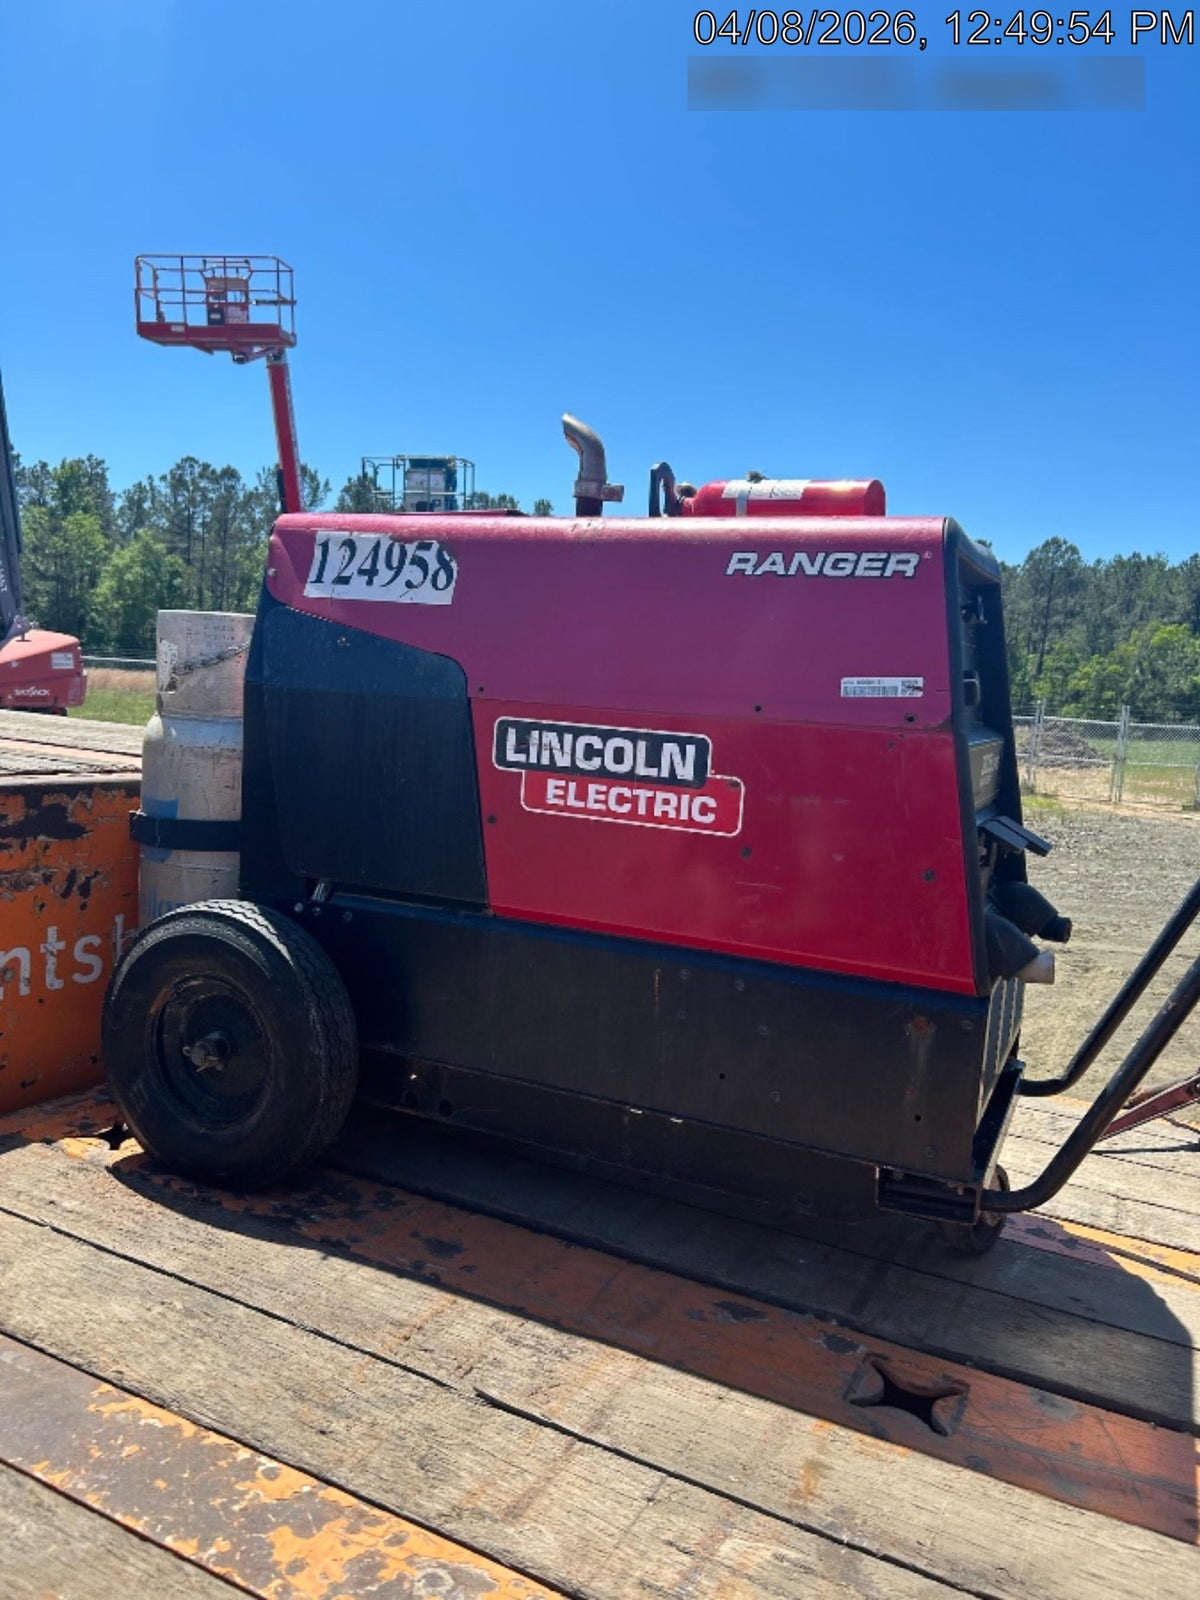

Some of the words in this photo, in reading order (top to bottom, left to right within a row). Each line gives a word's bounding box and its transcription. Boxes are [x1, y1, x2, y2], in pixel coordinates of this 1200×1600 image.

[309, 538, 455, 592] 124958
[505, 727, 696, 781] LINCOLN
[546, 778, 717, 823] ELECTRIC
